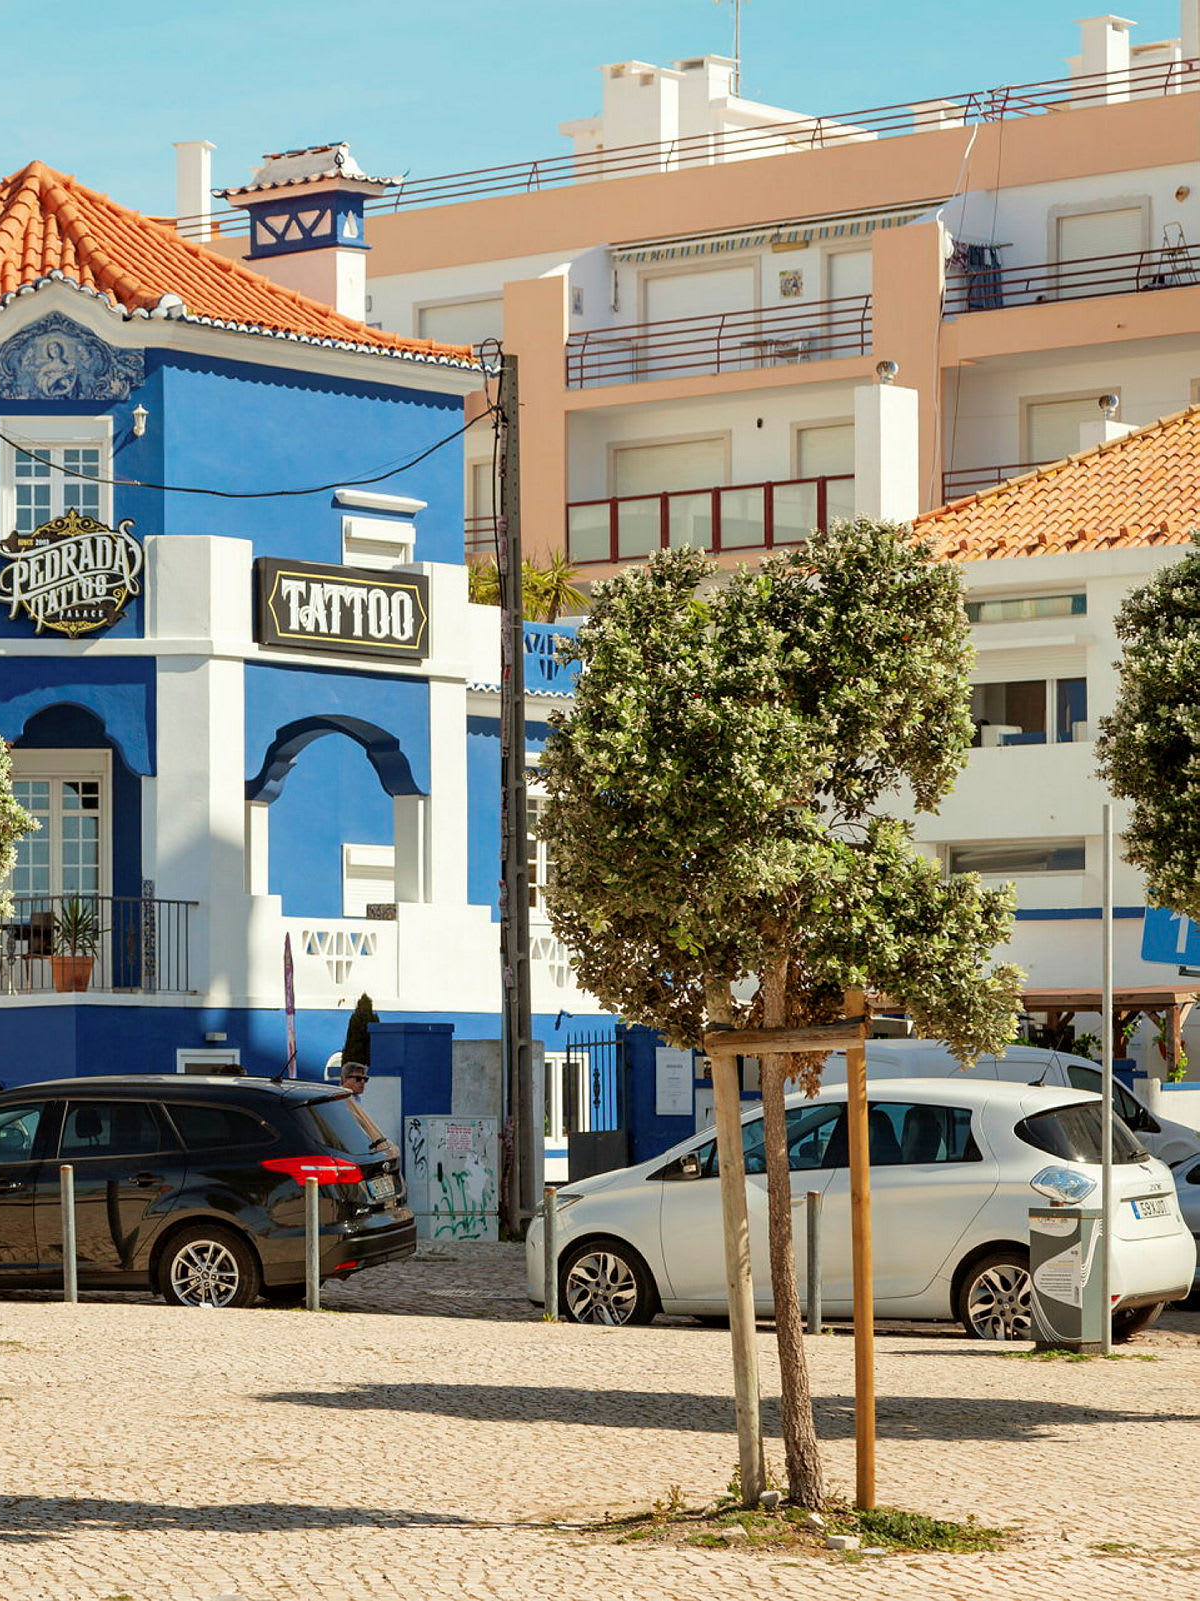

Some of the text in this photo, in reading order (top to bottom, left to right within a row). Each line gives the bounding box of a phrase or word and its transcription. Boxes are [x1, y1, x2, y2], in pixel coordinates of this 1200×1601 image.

[0, 534, 134, 620] PEDRADA
[29, 574, 109, 633] TATTOO
[58, 609, 105, 620] PALACE
[281, 578, 415, 642] TATTOO
